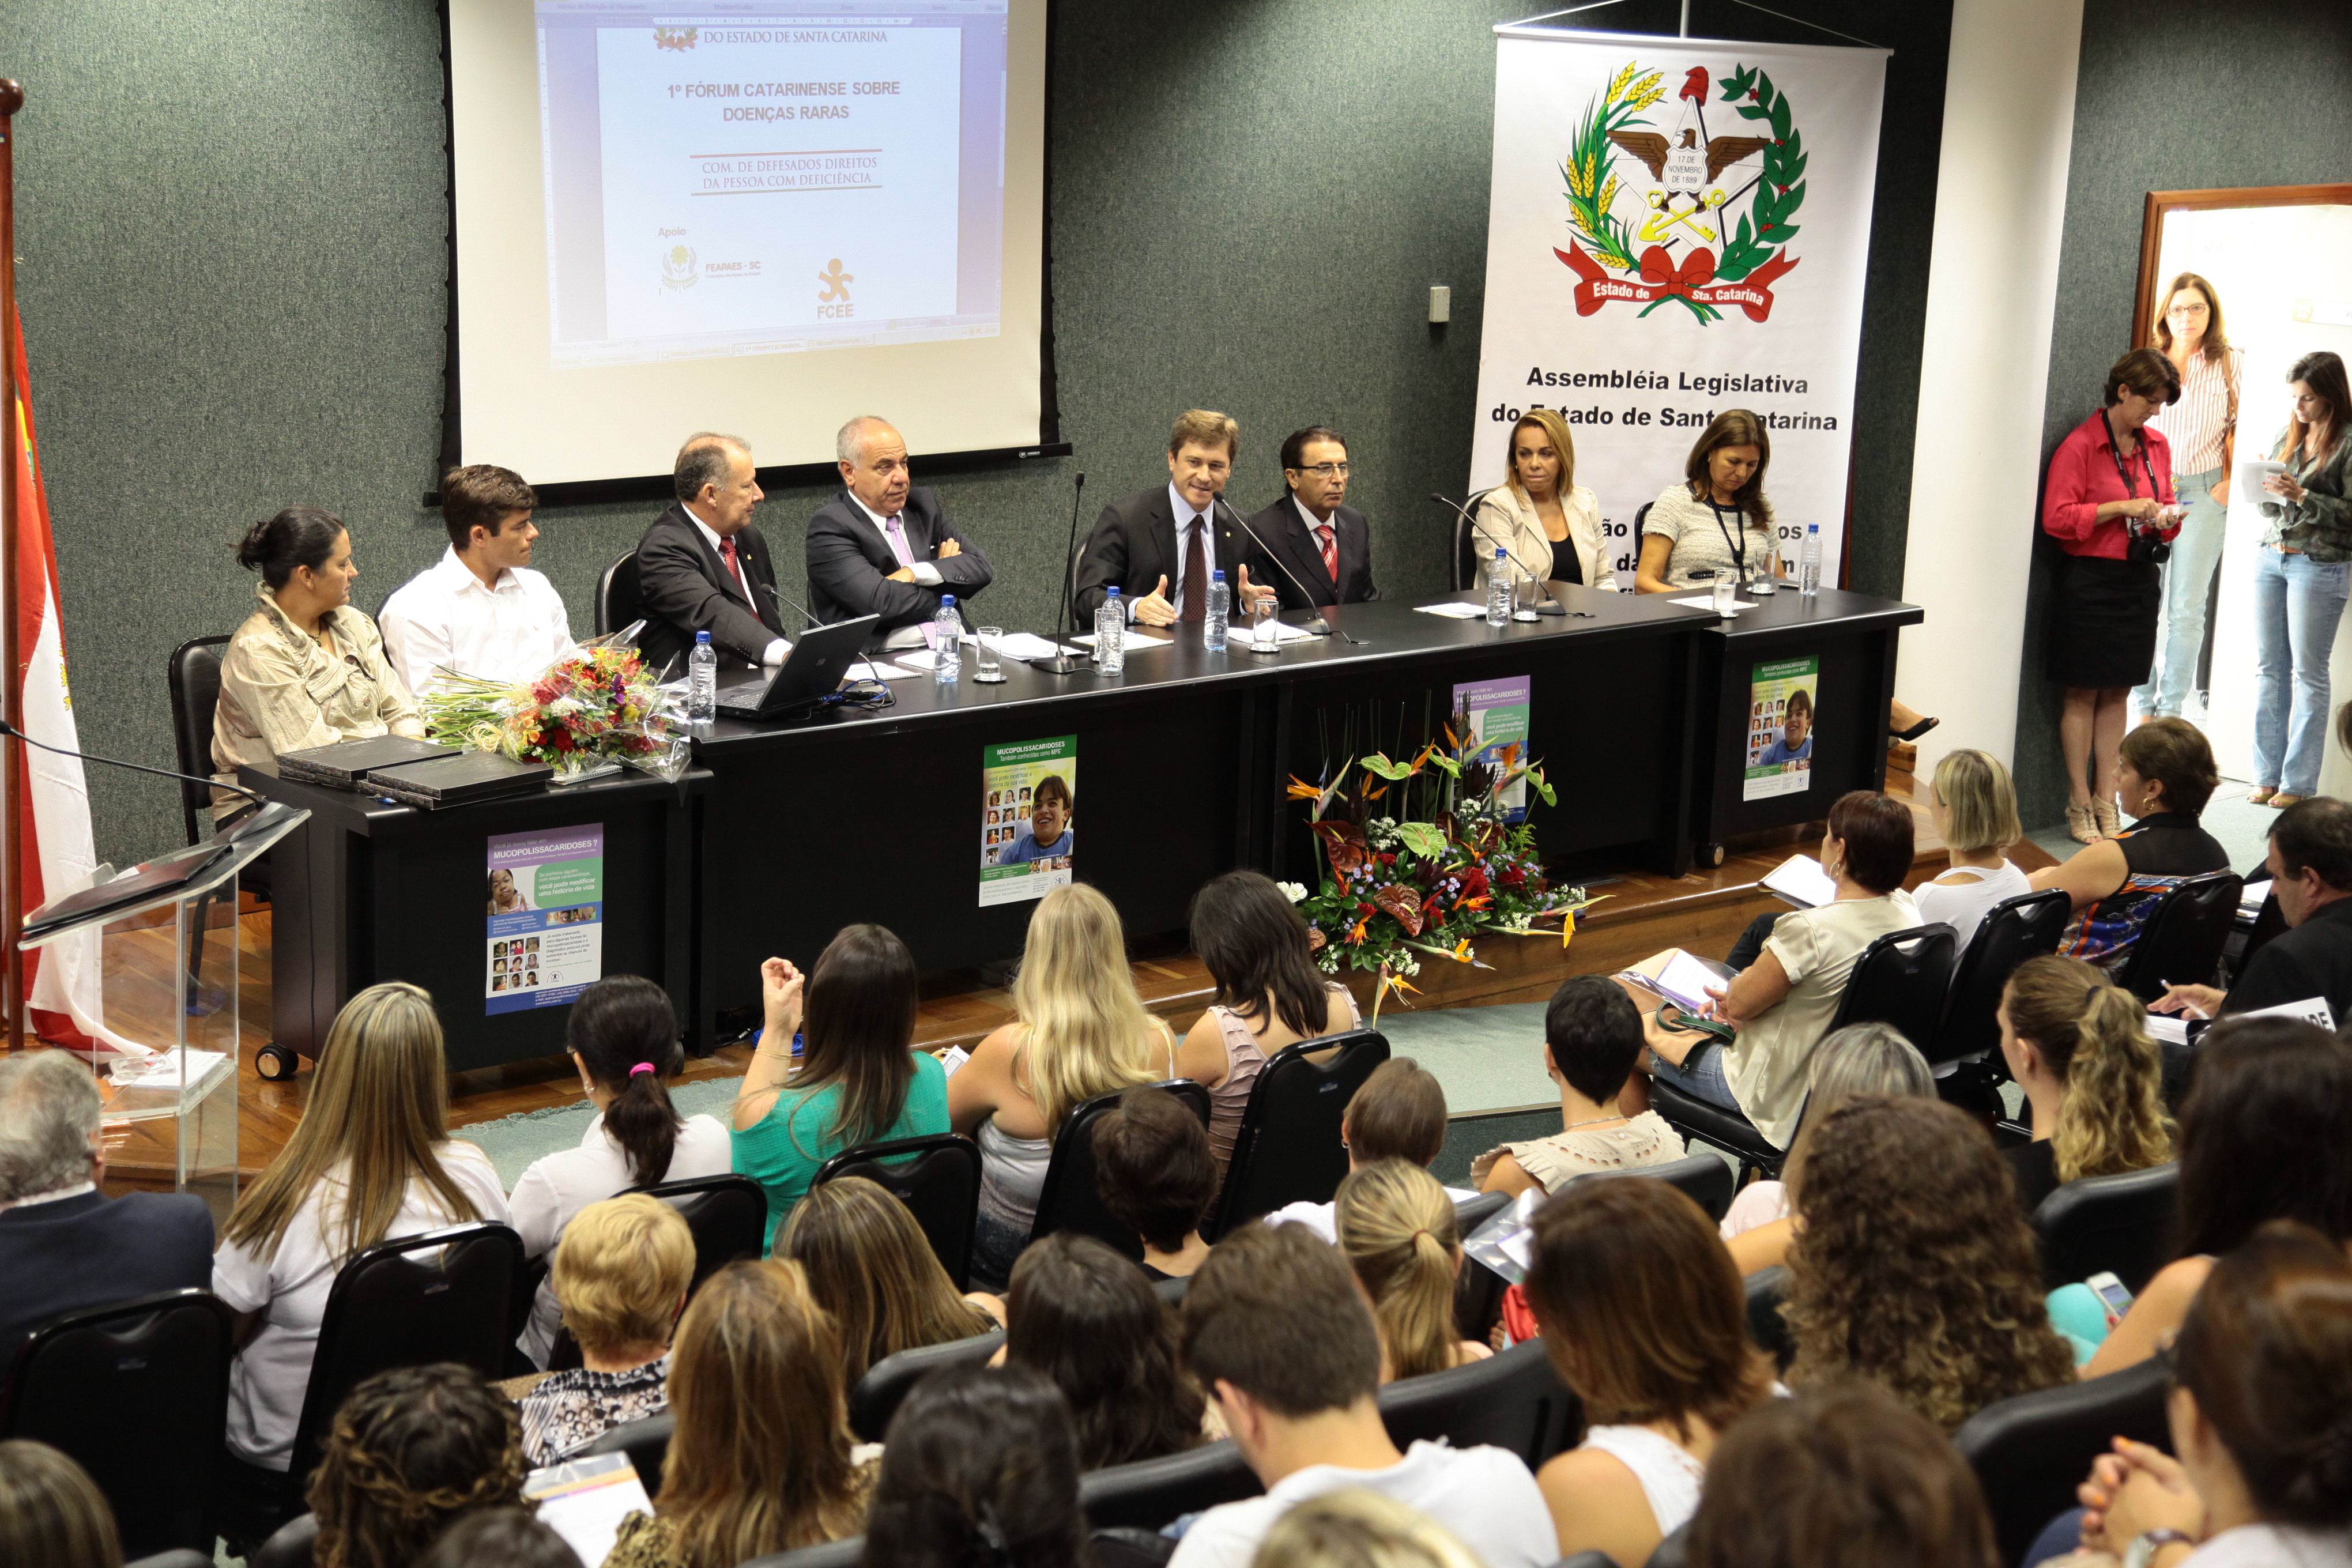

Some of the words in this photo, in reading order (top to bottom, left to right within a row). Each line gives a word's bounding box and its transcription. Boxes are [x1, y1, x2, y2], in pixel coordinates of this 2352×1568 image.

[704, 31, 723, 43] DO
[727, 31, 771, 43] ESTADO
[775, 31, 790, 43] DE
[793, 31, 829, 43] SANTA
[831, 31, 887, 43] CATARINA
[685, 81, 739, 98] FÓRUM
[744, 82, 846, 97] CATARINENSE
[853, 81, 900, 95] SOBRE
[723, 107, 794, 123] DOENÇAS
[800, 105, 849, 119] RARAS
[702, 162, 733, 174] COM.
[738, 161, 752, 172] DE
[757, 159, 821, 172] DEFESADOS
[825, 157, 876, 169] DIREITOS
[1668, 165, 1702, 174] NOVEMBRO
[703, 178, 719, 189] DA
[723, 176, 764, 188] PESSOA
[767, 175, 795, 186] COM
[799, 172, 870, 185] DEFICIÊNCIA
[658, 227, 686, 238] Apoio
[706, 262, 742, 272] FEAPAES
[749, 261, 761, 269] SC
[1593, 282, 1633, 298] Estado
[1636, 288, 1649, 299] de
[1692, 289, 1713, 301] Sta.
[1716, 288, 1764, 306] Catarina
[817, 304, 854, 319] FCEE
[1526, 367, 1669, 390] Assembléia
[1679, 372, 1808, 396] Legislativa
[1491, 404, 1520, 422] do
[1531, 404, 1614, 425] tado
[1622, 407, 1651, 426] de
[1660, 408, 1714, 427] Sant
[1758, 410, 1838, 430] tarina
[1762, 659, 1810, 672] MUCOPOLISSACARIDOSES
[997, 741, 1065, 755] MUCOPOLISSACARIDOSES
[1000, 753, 1016, 762] Também
[1017, 751, 1039, 759] conhecidas
[493, 840, 591, 859] MUCOPOLISSACARIDOSES
[553, 880, 568, 888] pode
[569, 877, 595, 885] modificar
